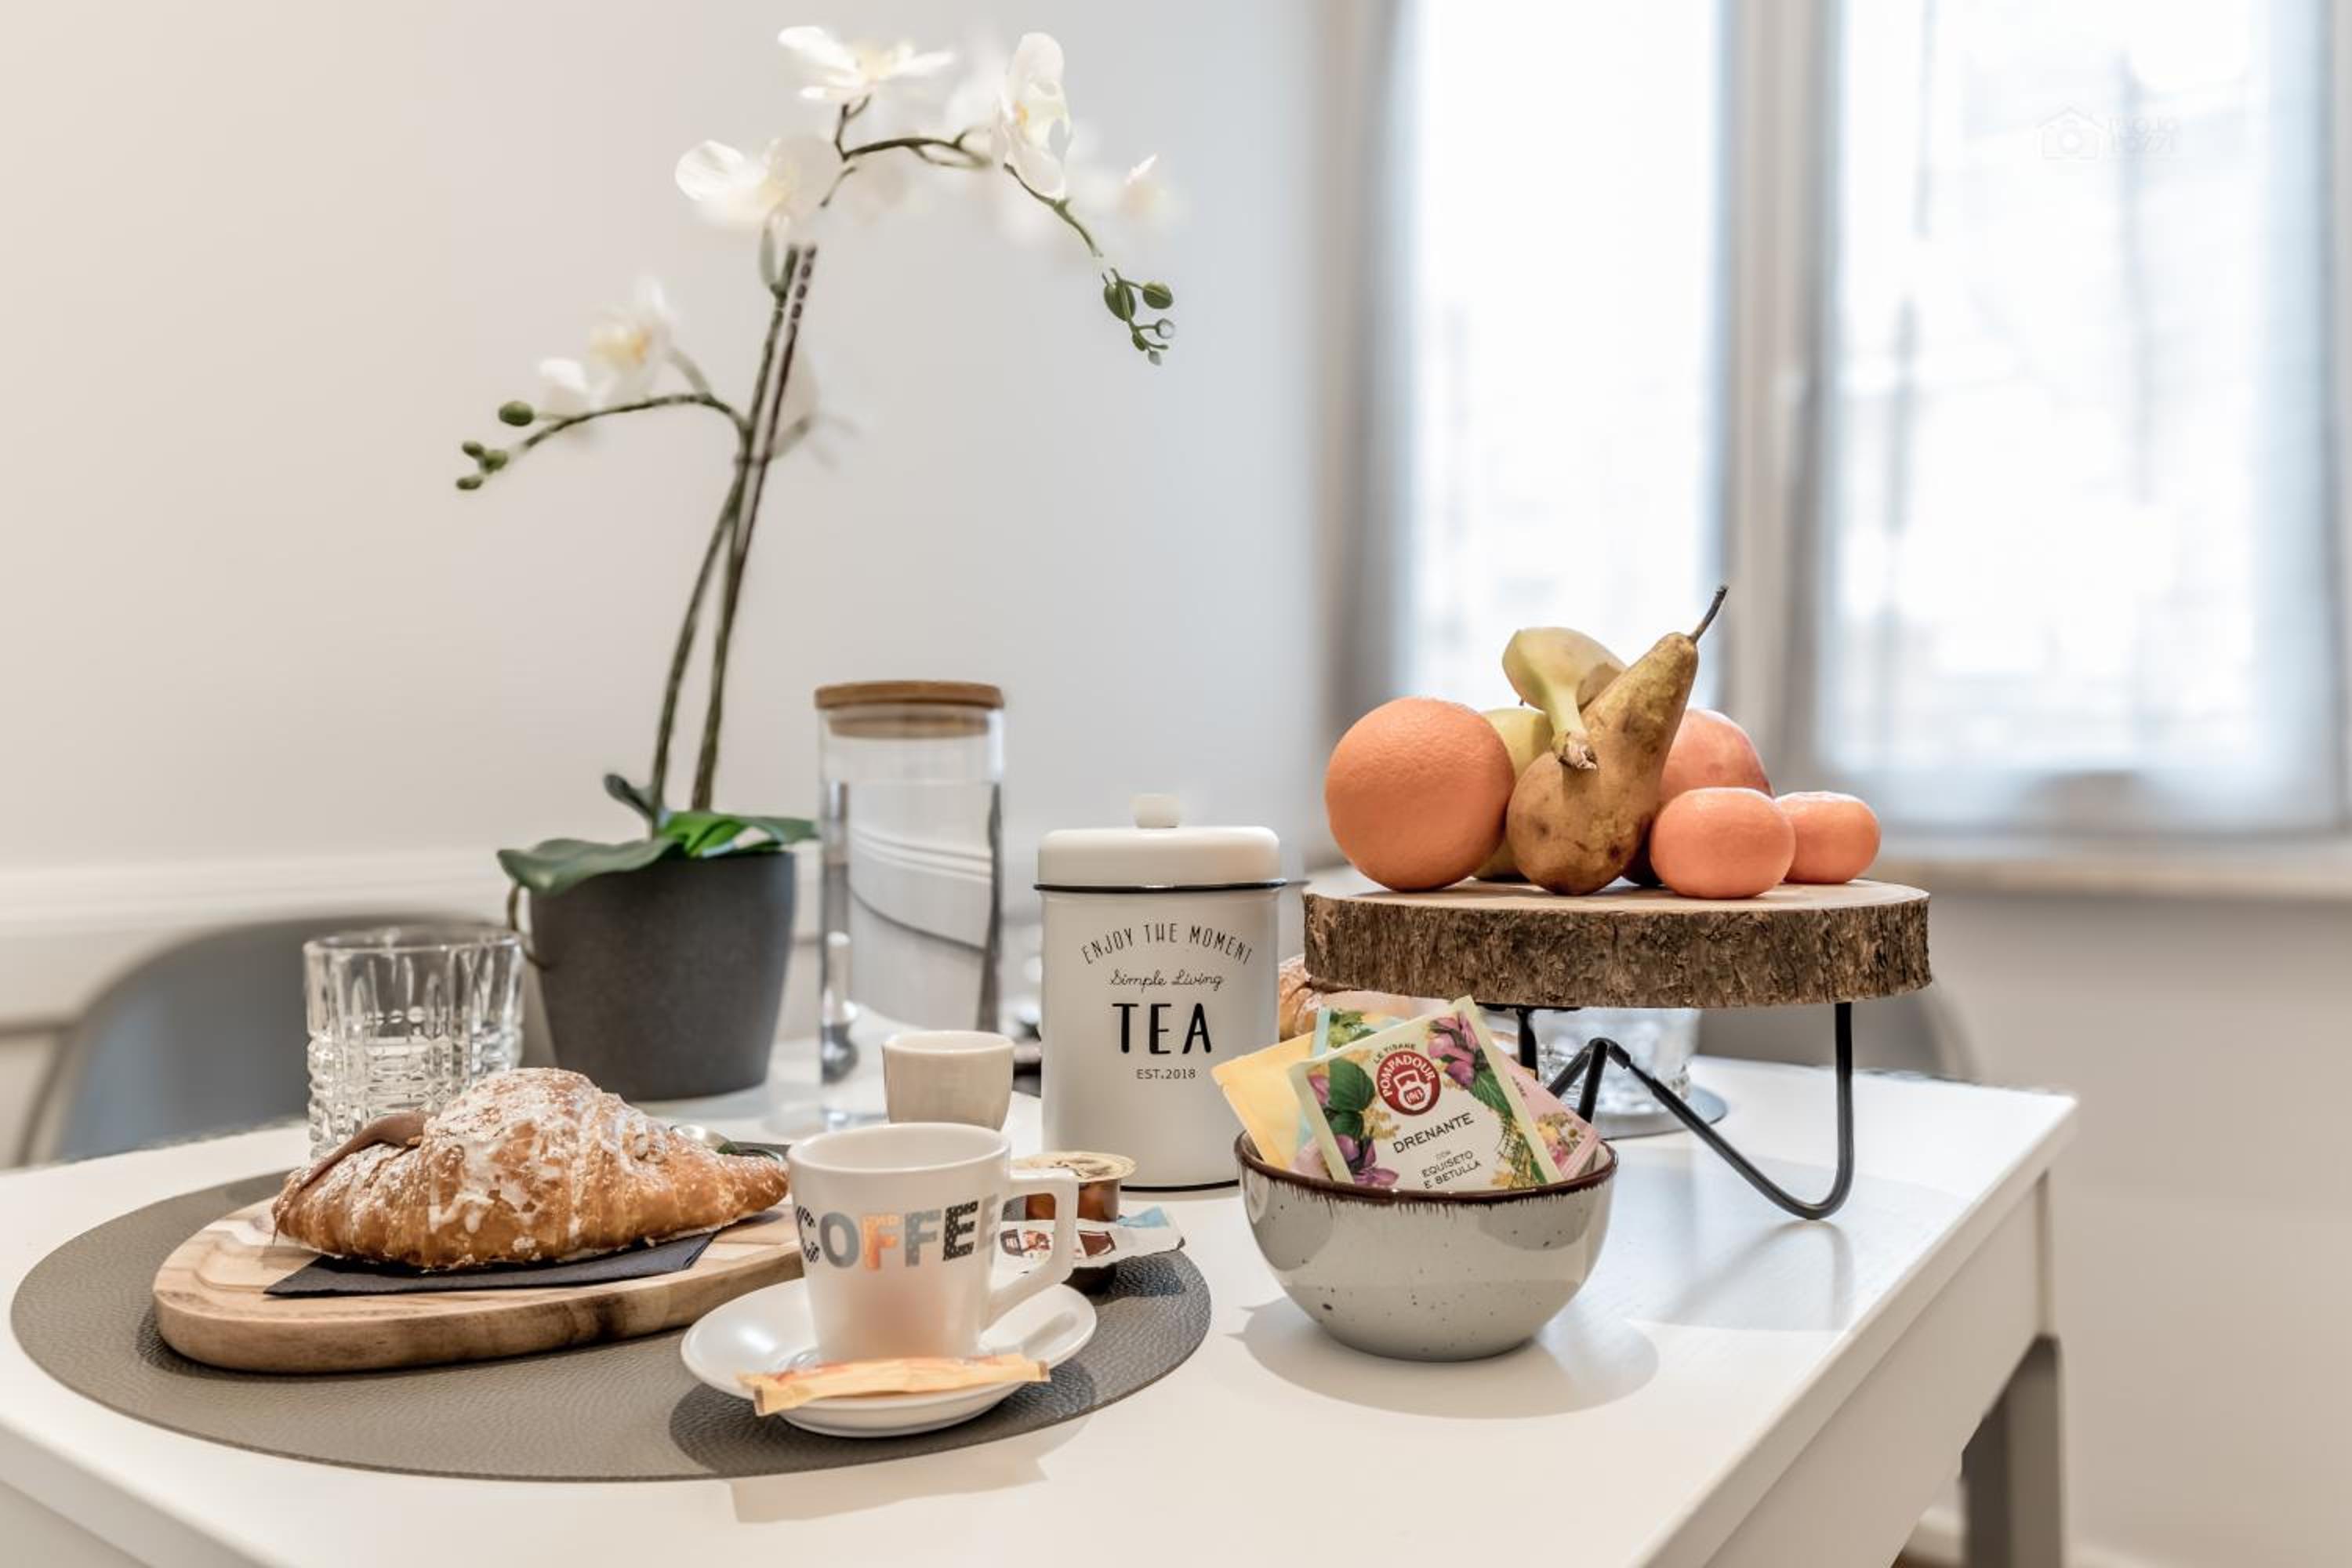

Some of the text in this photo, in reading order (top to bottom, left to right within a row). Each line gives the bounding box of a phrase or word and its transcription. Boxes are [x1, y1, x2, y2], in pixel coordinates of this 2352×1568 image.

[1081, 923, 1253, 965] ENJOY THE MOMENT
[1109, 969, 1225, 993] Simple Living
[1112, 1003, 1213, 1054] TEA
[1136, 1069, 1196, 1080] EST.2018
[1380, 1054, 1436, 1098] POMPADOUR
[1392, 1112, 1474, 1153] DRENANTE
[1421, 1150, 1473, 1178] EQUISETO
[1423, 1160, 1483, 1189] E BETULLA
